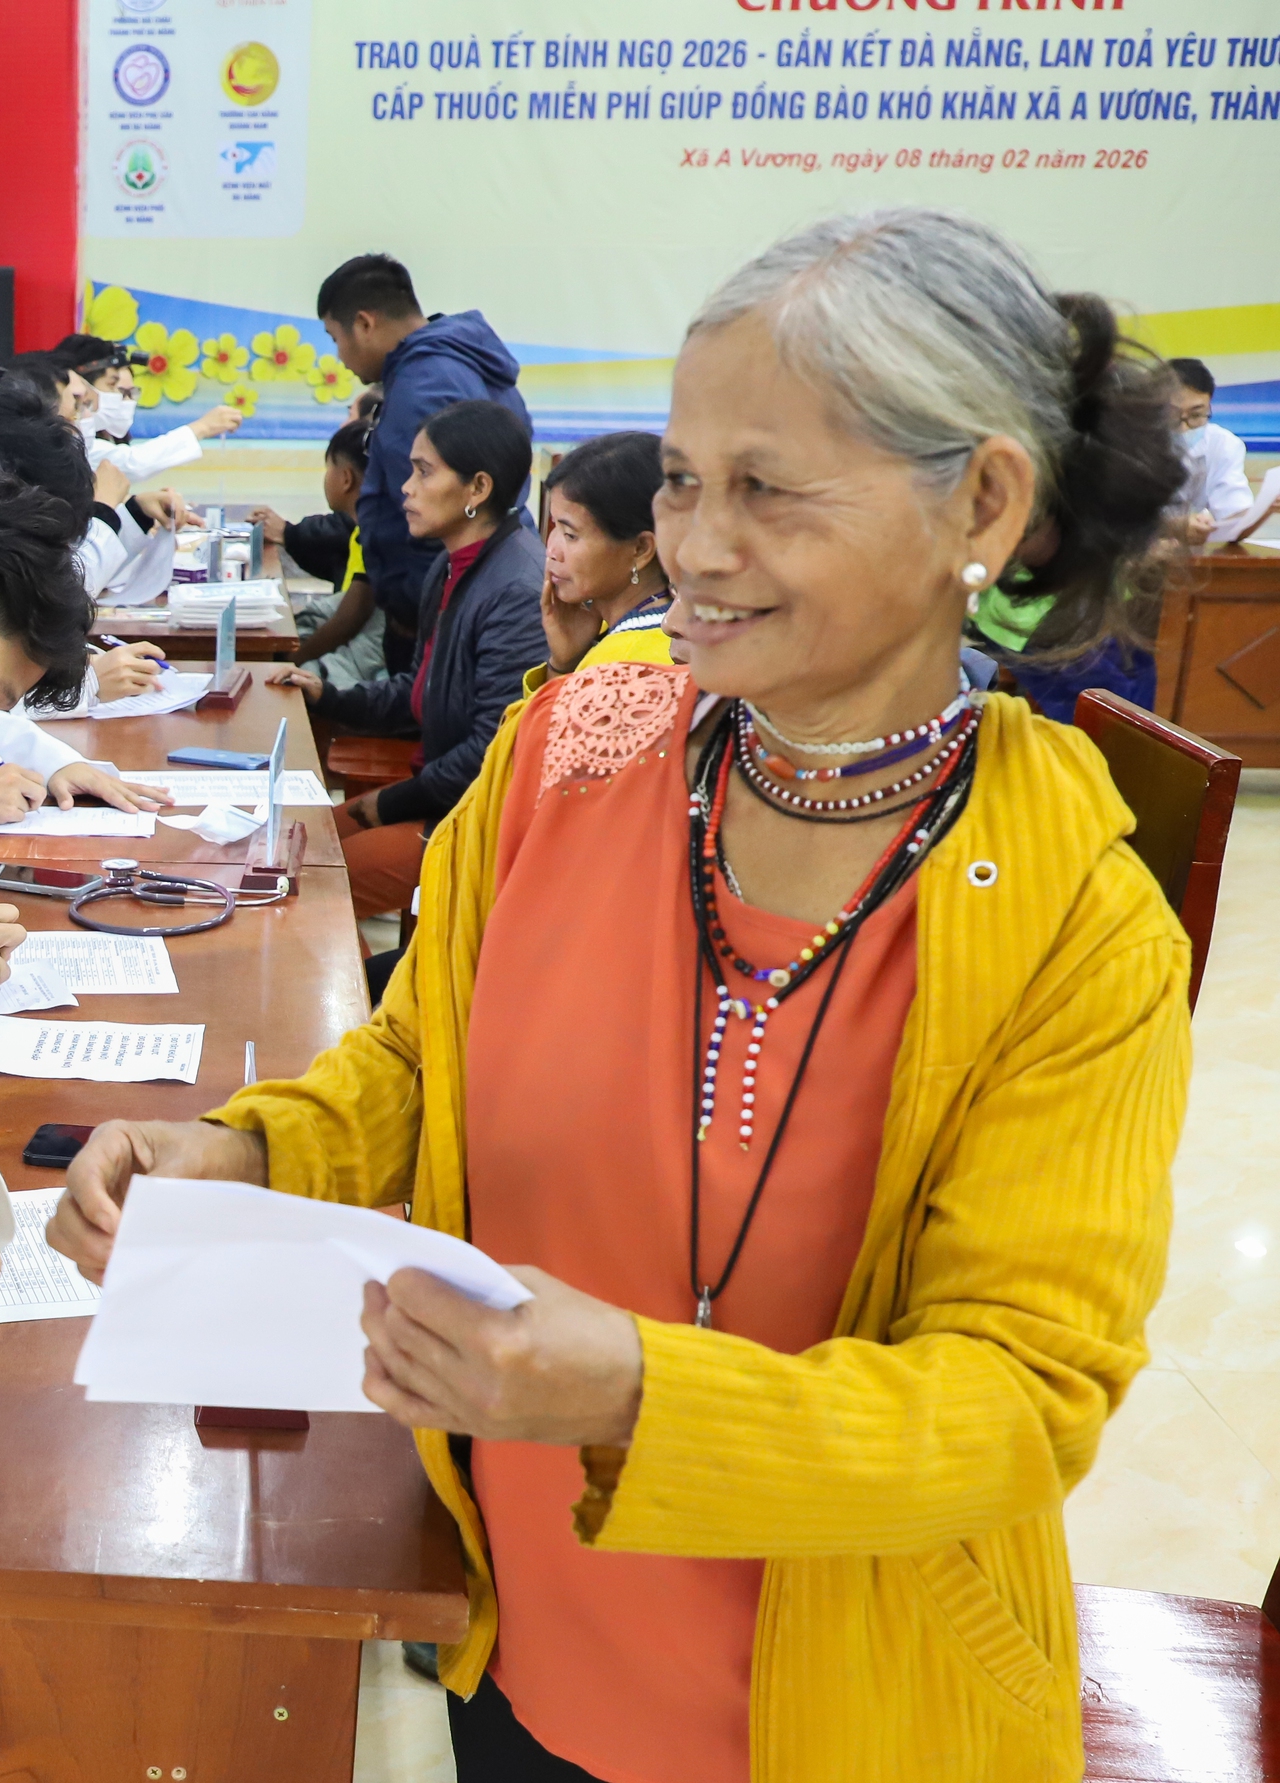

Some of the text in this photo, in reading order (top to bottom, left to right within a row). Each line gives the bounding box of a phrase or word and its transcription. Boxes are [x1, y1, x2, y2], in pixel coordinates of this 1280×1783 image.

[355, 41, 419, 69] TRAO
[429, 34, 480, 72] QUÀ
[491, 30, 535, 69] TẾT
[545, 33, 608, 69] BÍNH
[618, 40, 672, 74] NGỌ
[682, 39, 748, 68] 2026
[776, 27, 832, 68] GẮN
[842, 28, 891, 68] KẾT
[900, 32, 934, 68] ĐÀ
[945, 27, 1029, 71] NẴNG,
[1040, 38, 1093, 68] LAN
[1104, 28, 1153, 68] TOẢ
[1166, 32, 1217, 68] YÊU
[1227, 35, 1280, 67] THƯ
[372, 82, 424, 120] CẤP
[435, 81, 518, 120] THUỐC
[528, 81, 596, 120] MIỄN
[606, 85, 651, 120] PHÍ
[660, 85, 722, 120] GIÚP
[732, 81, 805, 120] ĐỒNG
[815, 84, 868, 120] BÀO
[878, 85, 932, 120] KHÓ
[941, 84, 1017, 120] KHĂN
[1026, 85, 1061, 120] XÃ
[1071, 91, 1087, 120] A
[1100, 88, 1197, 124] VƯƠNG,
[680, 148, 1149, 173] Xã A Vương, ngày 08 tháng 02 năm 2026
